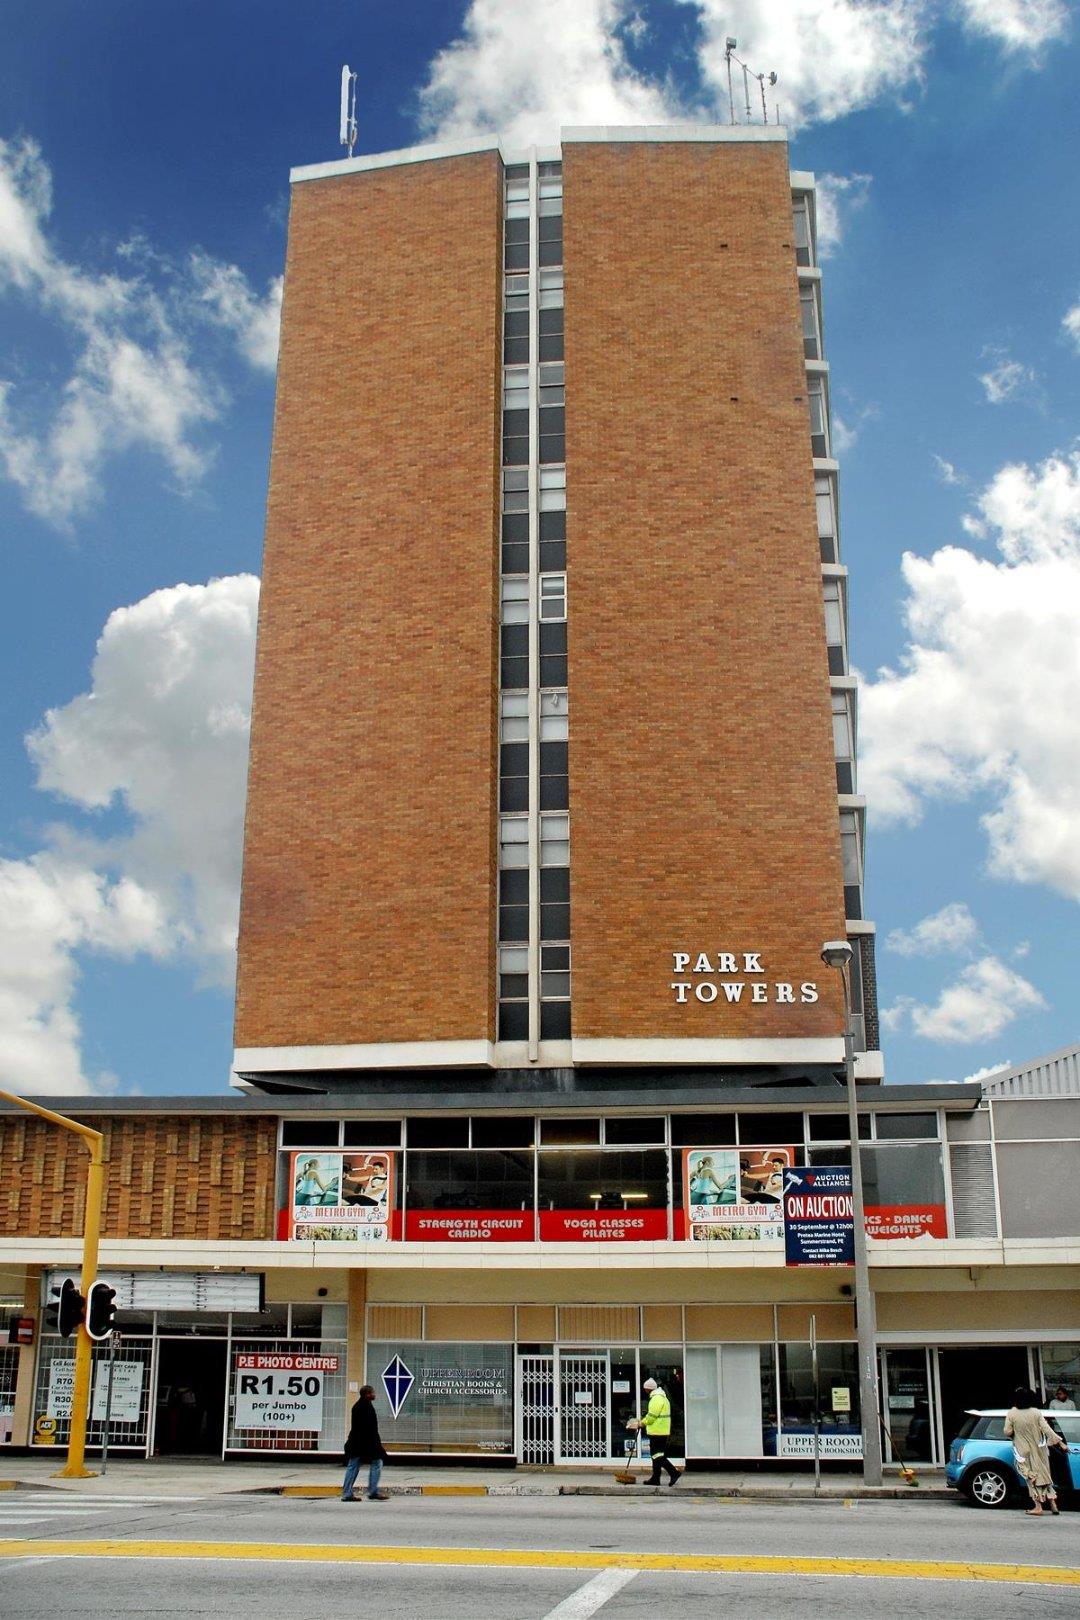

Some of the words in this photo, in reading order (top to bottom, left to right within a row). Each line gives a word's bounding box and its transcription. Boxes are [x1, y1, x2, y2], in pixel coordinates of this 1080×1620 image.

[673, 953, 764, 973] PARK
[671, 982, 819, 1003] TOWERS
[315, 1207, 345, 1217] METRO
[347, 1207, 366, 1217] GYM
[712, 1206, 745, 1216] METRO
[747, 1206, 767, 1216] GYM
[787, 1196, 804, 1218] ON
[806, 1196, 853, 1218] AUCTION
[419, 1219, 477, 1229] STRENGTH
[480, 1219, 523, 1229] CIRCUIT
[564, 1219, 596, 1229] YOGA
[599, 1218, 644, 1228] CLASSES
[894, 1215, 933, 1224] DANCE
[797, 1223, 828, 1231] September
[868, 1225, 922, 1234] WEIGHTS
[447, 1229, 491, 1238] CARDIO
[582, 1228, 625, 1238] PILATES
[239, 1356, 254, 1368] P.E
[258, 1356, 293, 1368] PHOTO
[295, 1357, 337, 1369] CENTRE
[421, 1368, 462, 1379] UPPER
[464, 1368, 505, 1379] ROOM
[241, 1375, 320, 1396] R1.50
[467, 1380, 494, 1388] BOOKS
[252, 1402, 268, 1410] per
[272, 1401, 307, 1410] Jumbo
[262, 1412, 295, 1422] (100+)
[787, 1437, 823, 1446] UPPER
[826, 1437, 860, 1446] ROOM
